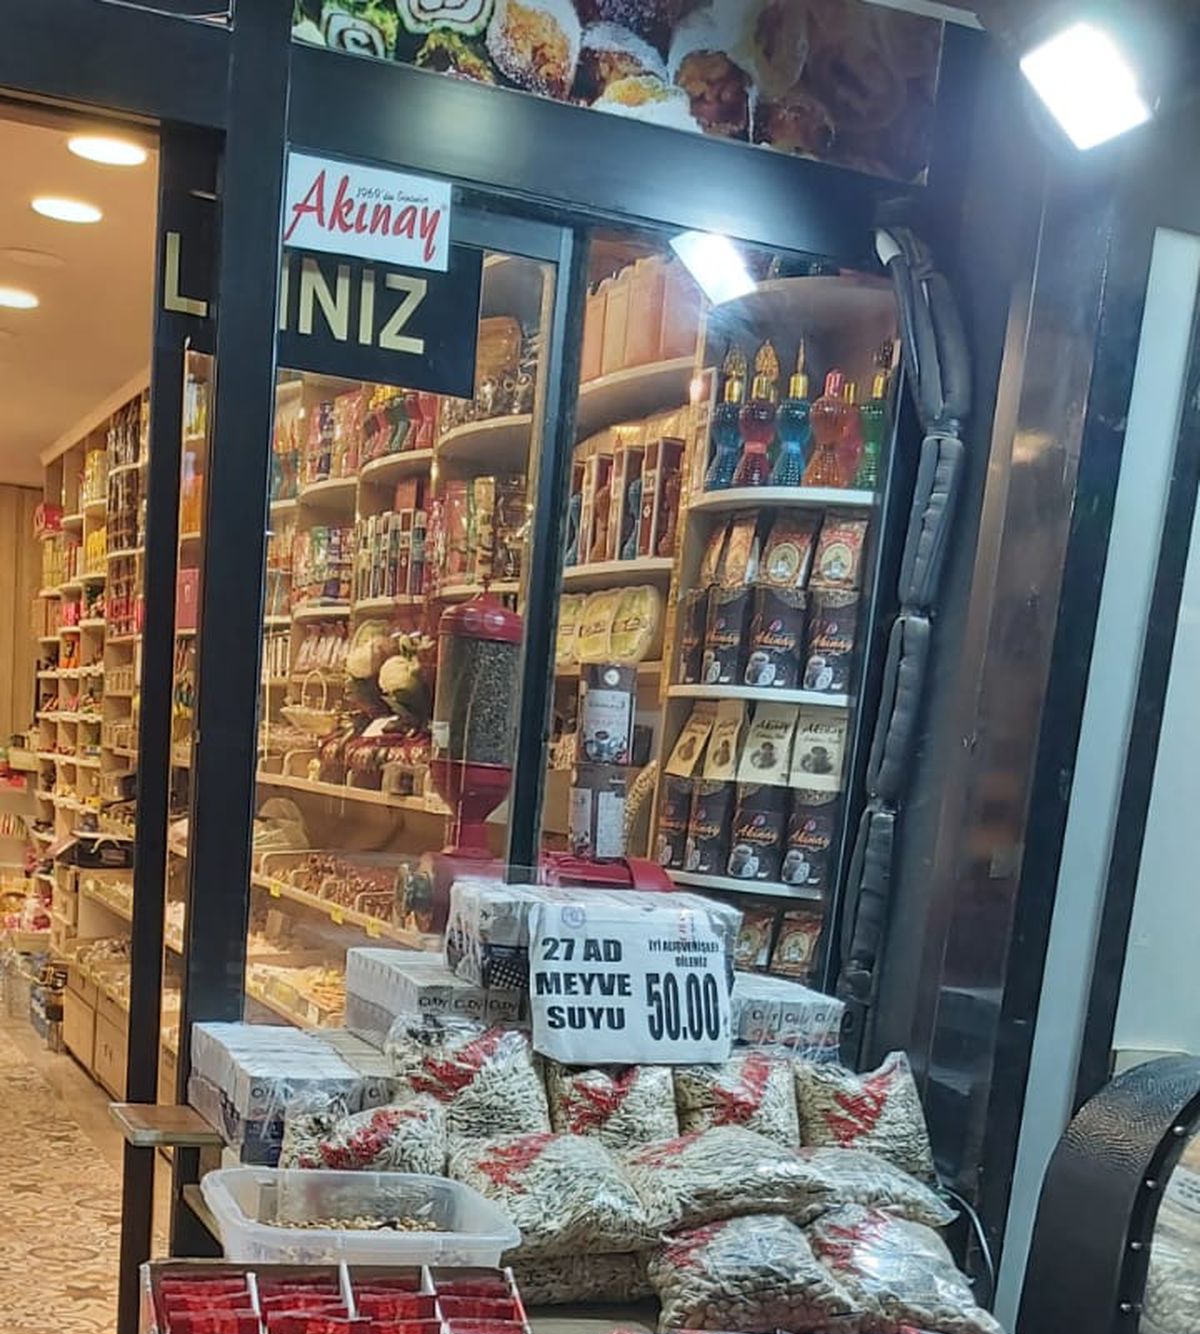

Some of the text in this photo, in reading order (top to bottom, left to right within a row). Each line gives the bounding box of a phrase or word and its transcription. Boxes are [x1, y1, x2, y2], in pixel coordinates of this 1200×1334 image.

[541, 937, 622, 962] 27 AD
[535, 972, 632, 996] MEYVE
[547, 1005, 625, 1030] SUYU
[645, 971, 720, 1041] 50.00
